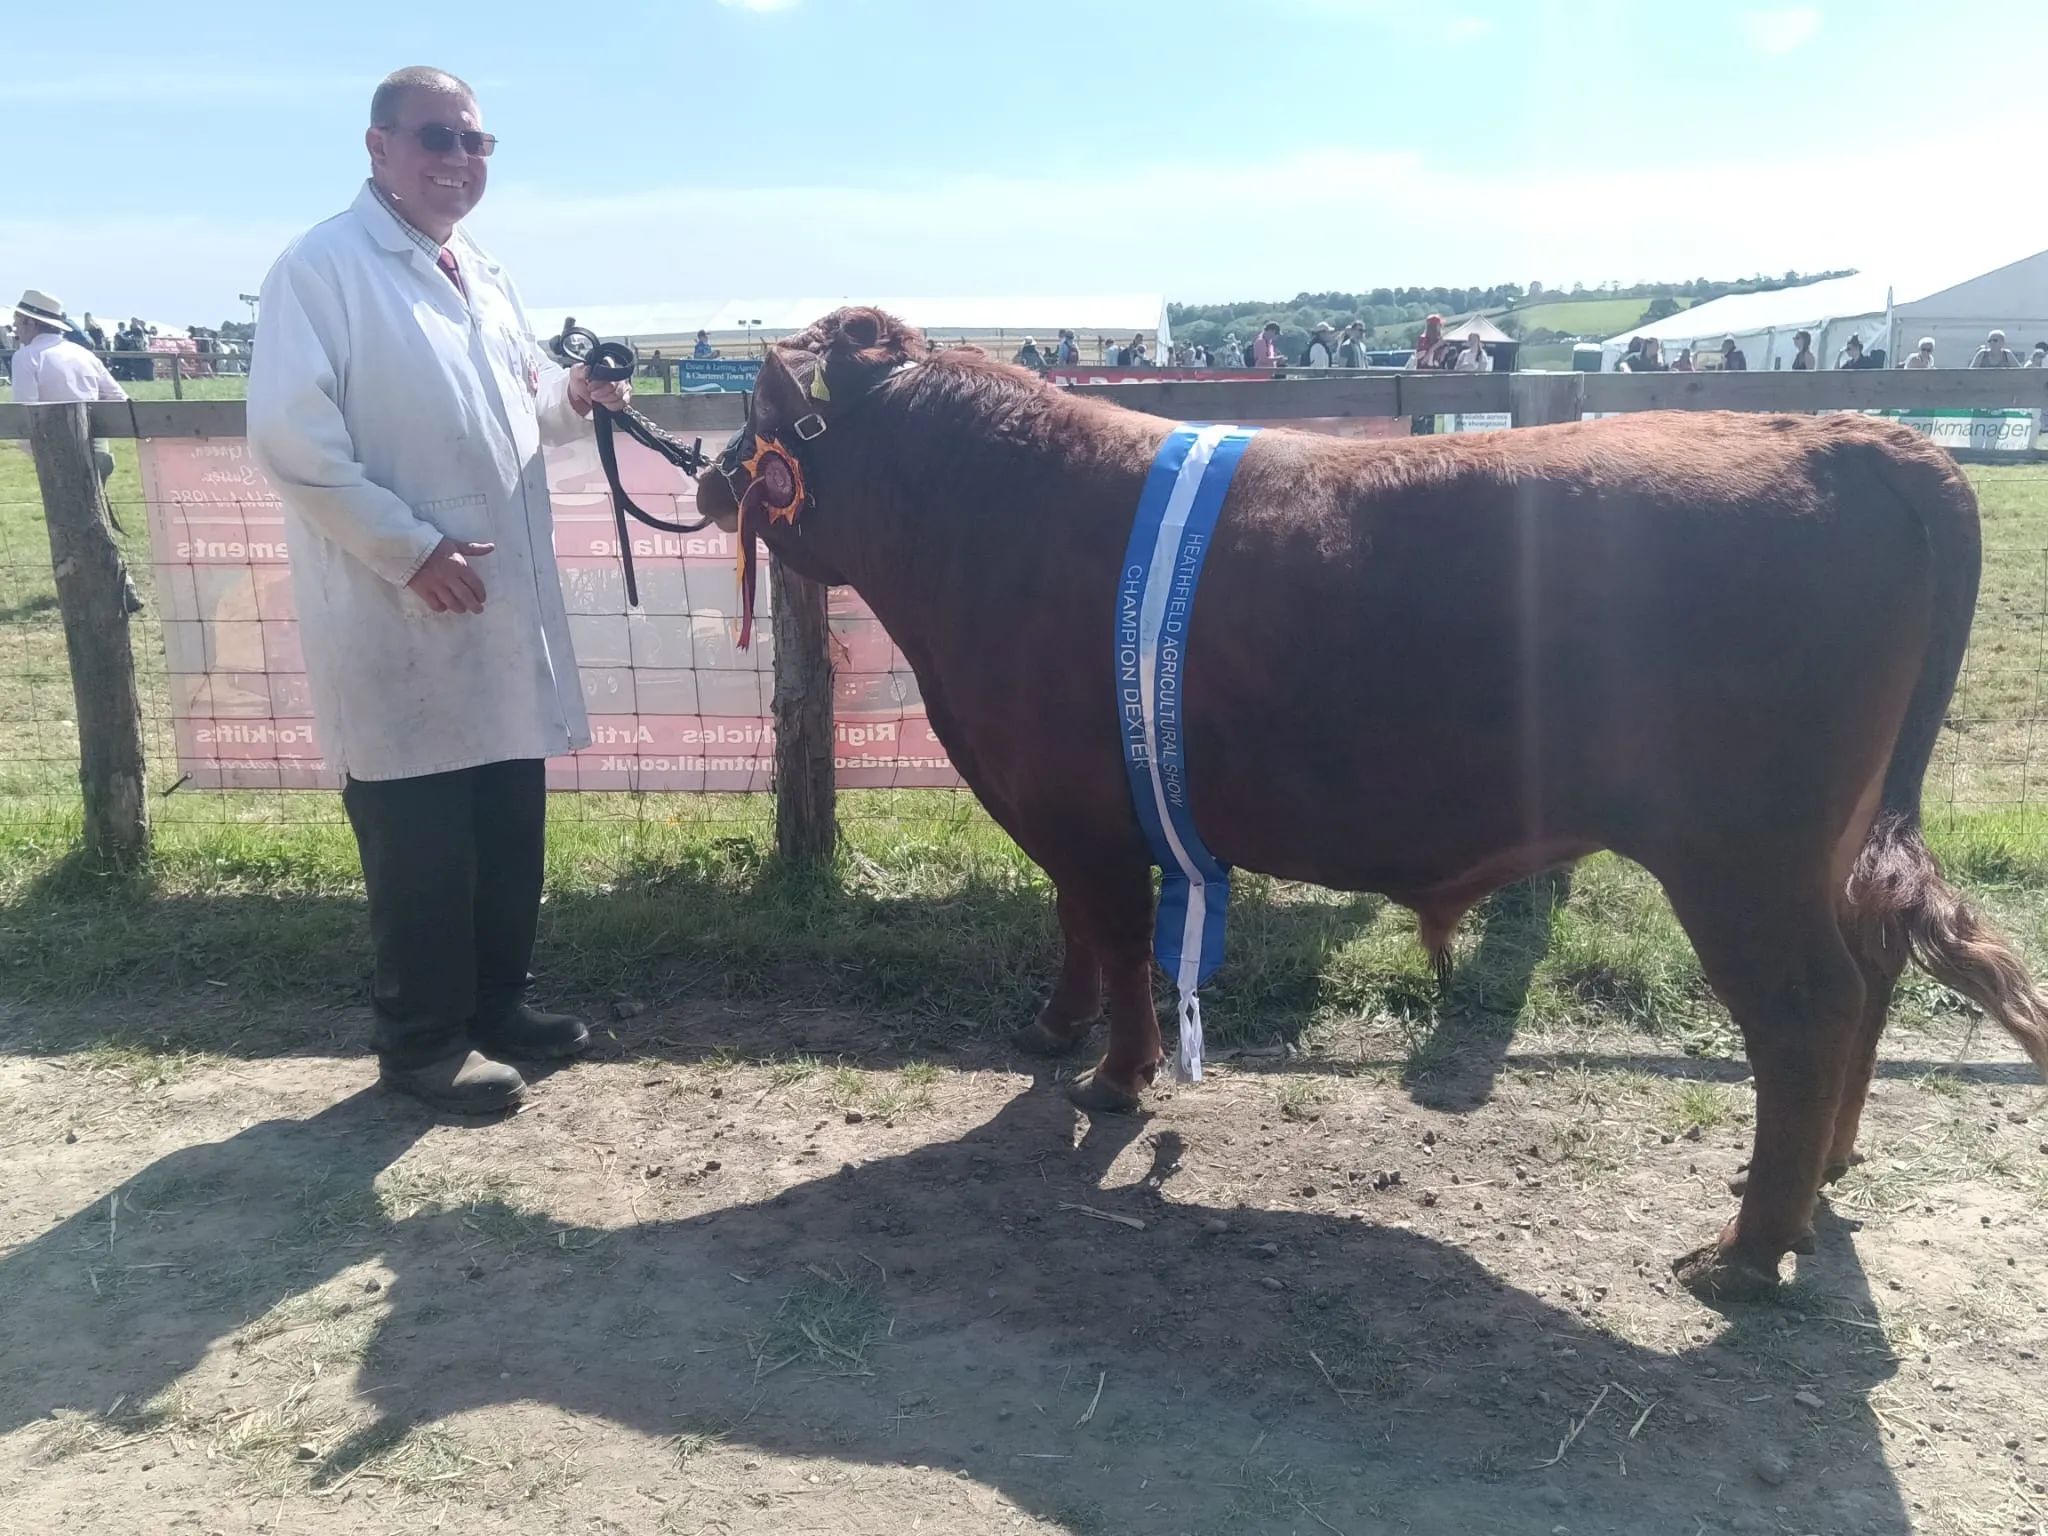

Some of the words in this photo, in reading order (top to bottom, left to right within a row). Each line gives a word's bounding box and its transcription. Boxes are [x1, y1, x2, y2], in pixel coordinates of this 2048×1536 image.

[692, 372, 725, 380] Chartered
[727, 372, 745, 380] Town
[1120, 564, 1143, 682] CHAMPION
[1166, 532, 1204, 633] HEATHFIELD
[1123, 688, 1150, 770] DEXTER
[1159, 636, 1179, 760] AGRICULTURAL
[1163, 762, 1184, 808] SHOW
